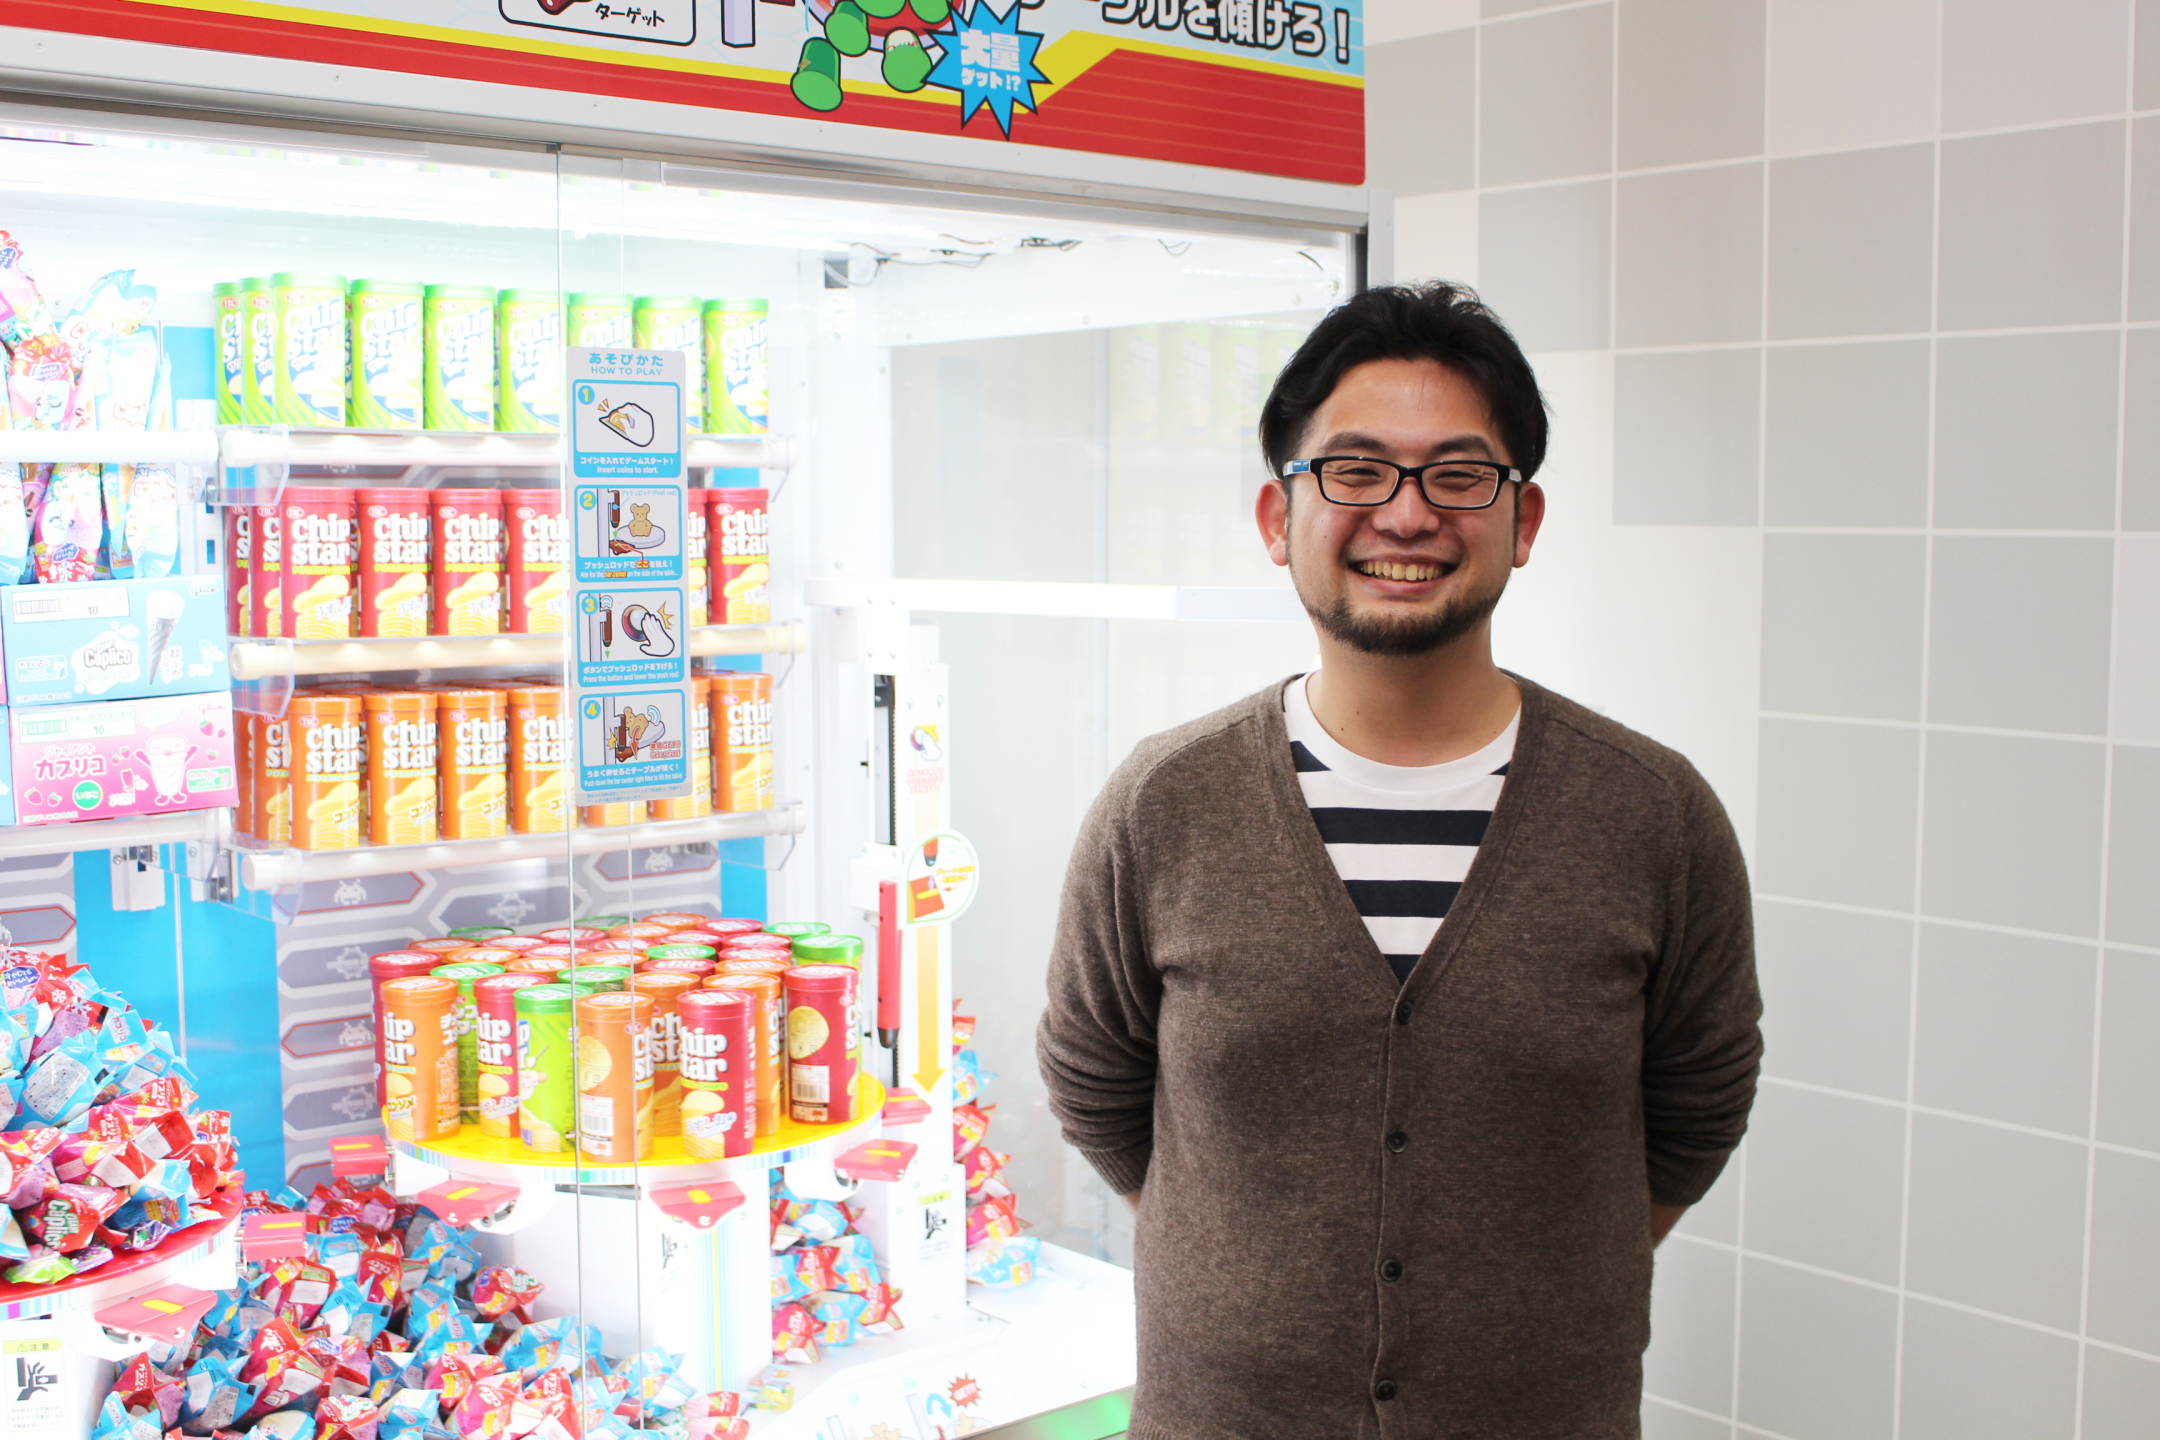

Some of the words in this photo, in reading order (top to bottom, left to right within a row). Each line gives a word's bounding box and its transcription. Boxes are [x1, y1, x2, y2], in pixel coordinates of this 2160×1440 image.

[595, 3, 664, 27] ターゲット
[960, 30, 1020, 71] 大量
[961, 69, 1022, 91] ゲット!?
[589, 352, 664, 366] あそびかた
[591, 366, 615, 374] HOW
[619, 367, 632, 375] TO
[636, 368, 662, 376] PLAY
[582, 388, 590, 401] 1
[580, 456, 673, 465] コインを入れてゲームスタート！
[583, 493, 593, 507] 2
[292, 513, 350, 542] chip
[374, 512, 428, 540] chip
[445, 512, 500, 540] chip
[721, 508, 768, 535] chip
[292, 540, 350, 565] star
[374, 538, 428, 563] star
[445, 540, 500, 563] star
[721, 534, 768, 555] star
[87, 605, 98, 615] 10
[584, 598, 595, 613] 3
[84, 646, 132, 670] Caplico
[583, 675, 597, 683] Press
[657, 672, 669, 680] push
[586, 703, 598, 716] 4
[727, 698, 772, 725] chip
[94, 725, 104, 735] 10
[305, 721, 360, 751] chip
[382, 718, 436, 747] chip
[455, 715, 506, 744] chip
[728, 723, 772, 745] star
[45, 743, 96, 756] ジャイアント
[305, 748, 360, 773] star
[382, 744, 436, 769] star
[455, 741, 506, 766] star
[36, 756, 105, 779] カプリコ
[75, 790, 100, 800] いちご
[112, 1014, 127, 1042] カプリコ
[680, 1026, 728, 1057] hip
[680, 1051, 728, 1081] tar
[65, 1213, 79, 1233] GIANT
[30, 1343, 49, 1352] 注意
